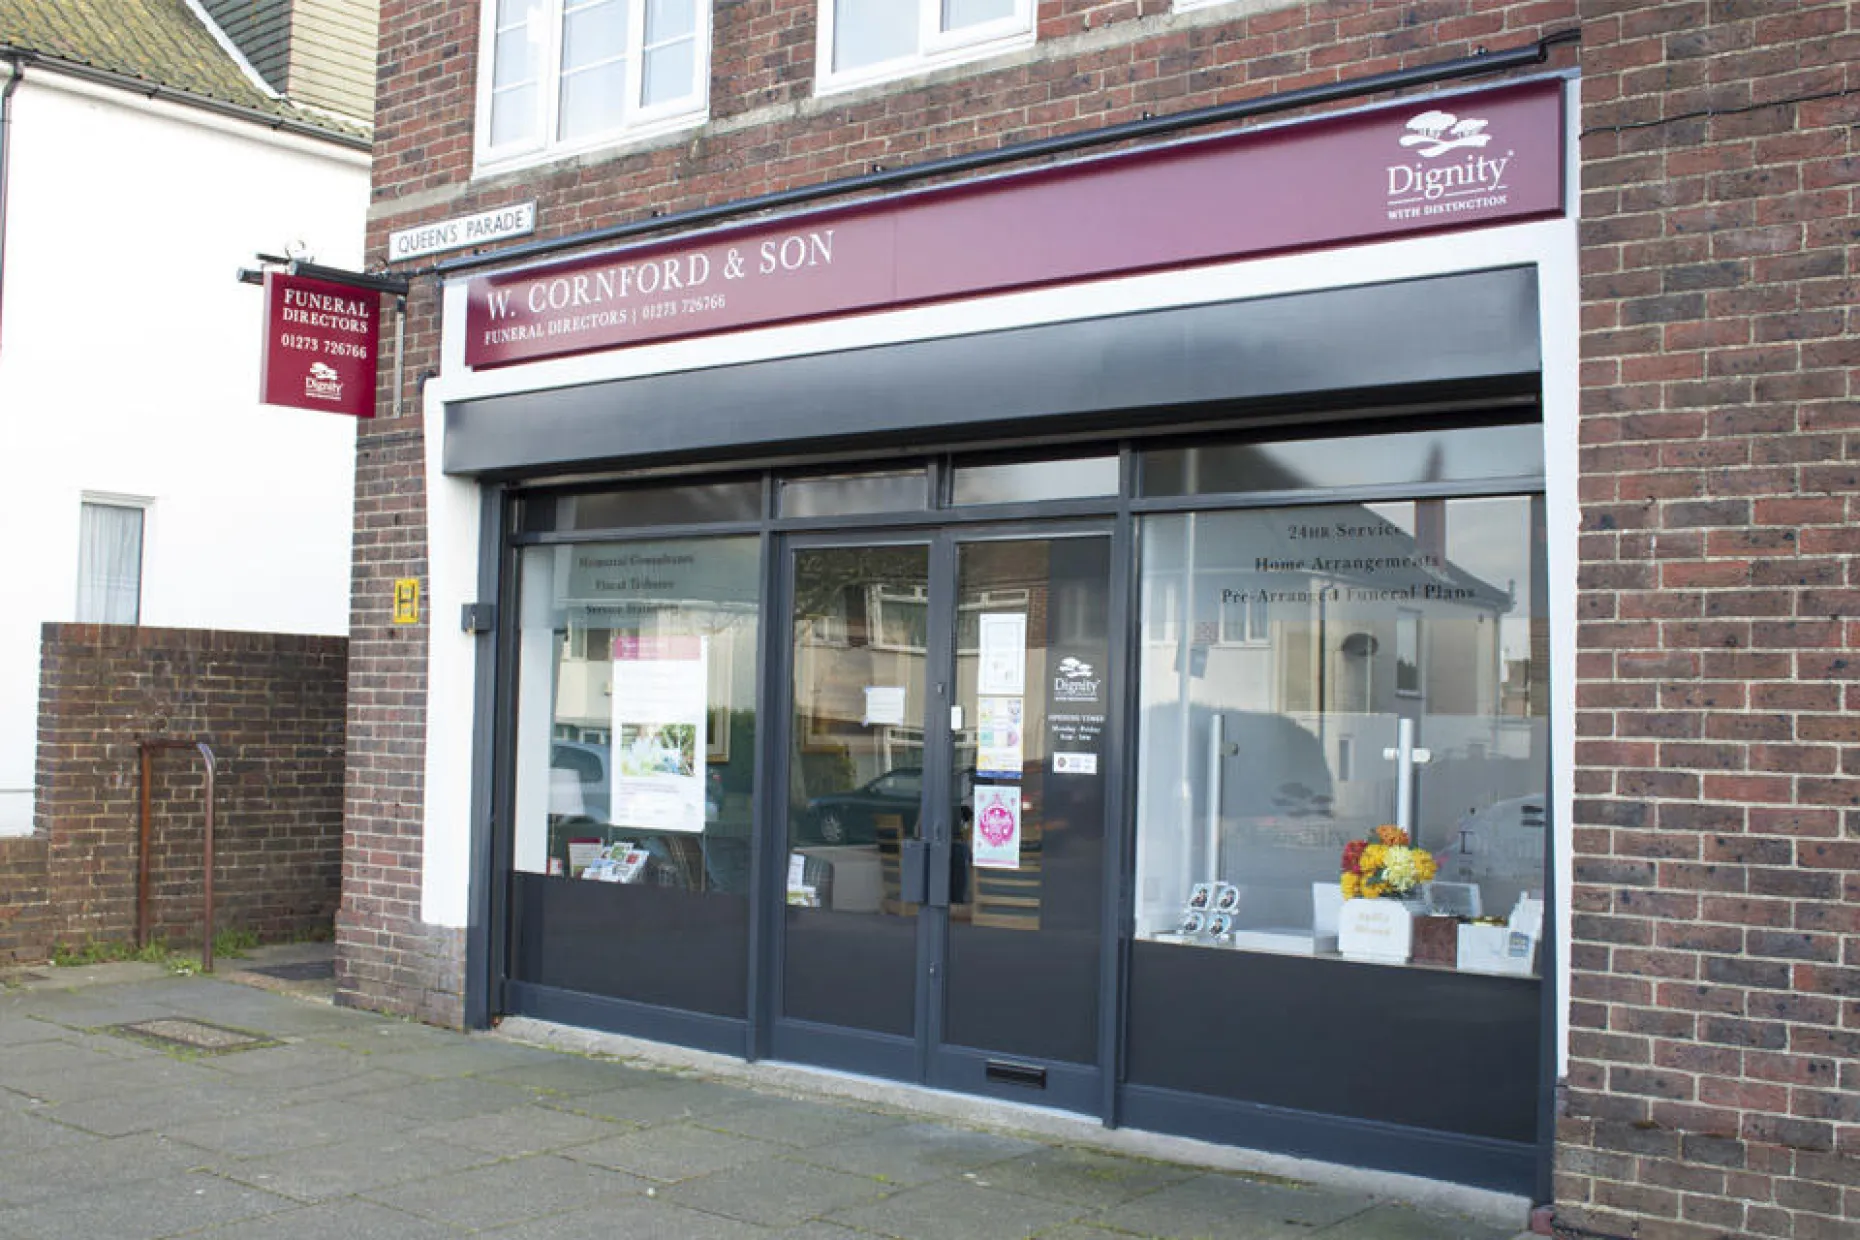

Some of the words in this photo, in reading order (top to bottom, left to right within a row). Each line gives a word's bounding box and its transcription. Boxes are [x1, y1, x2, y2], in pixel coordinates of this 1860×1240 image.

[1386, 153, 1508, 200] Dignity
[466, 209, 525, 238] PARADE
[486, 289, 516, 320] W.
[528, 252, 710, 313] CORNFORD
[723, 247, 745, 281] &
[759, 229, 835, 275] SON
[284, 287, 369, 318] FUNERAL
[282, 307, 368, 334] DIRECTORS
[484, 322, 545, 346] FUNERAL
[547, 308, 627, 336] DIRECTORS
[281, 332, 318, 352] 01273
[323, 340, 367, 359] 726766
[1254, 557, 1304, 573] Home
[398, 583, 415, 619] H
[1424, 583, 1475, 600] Plans
